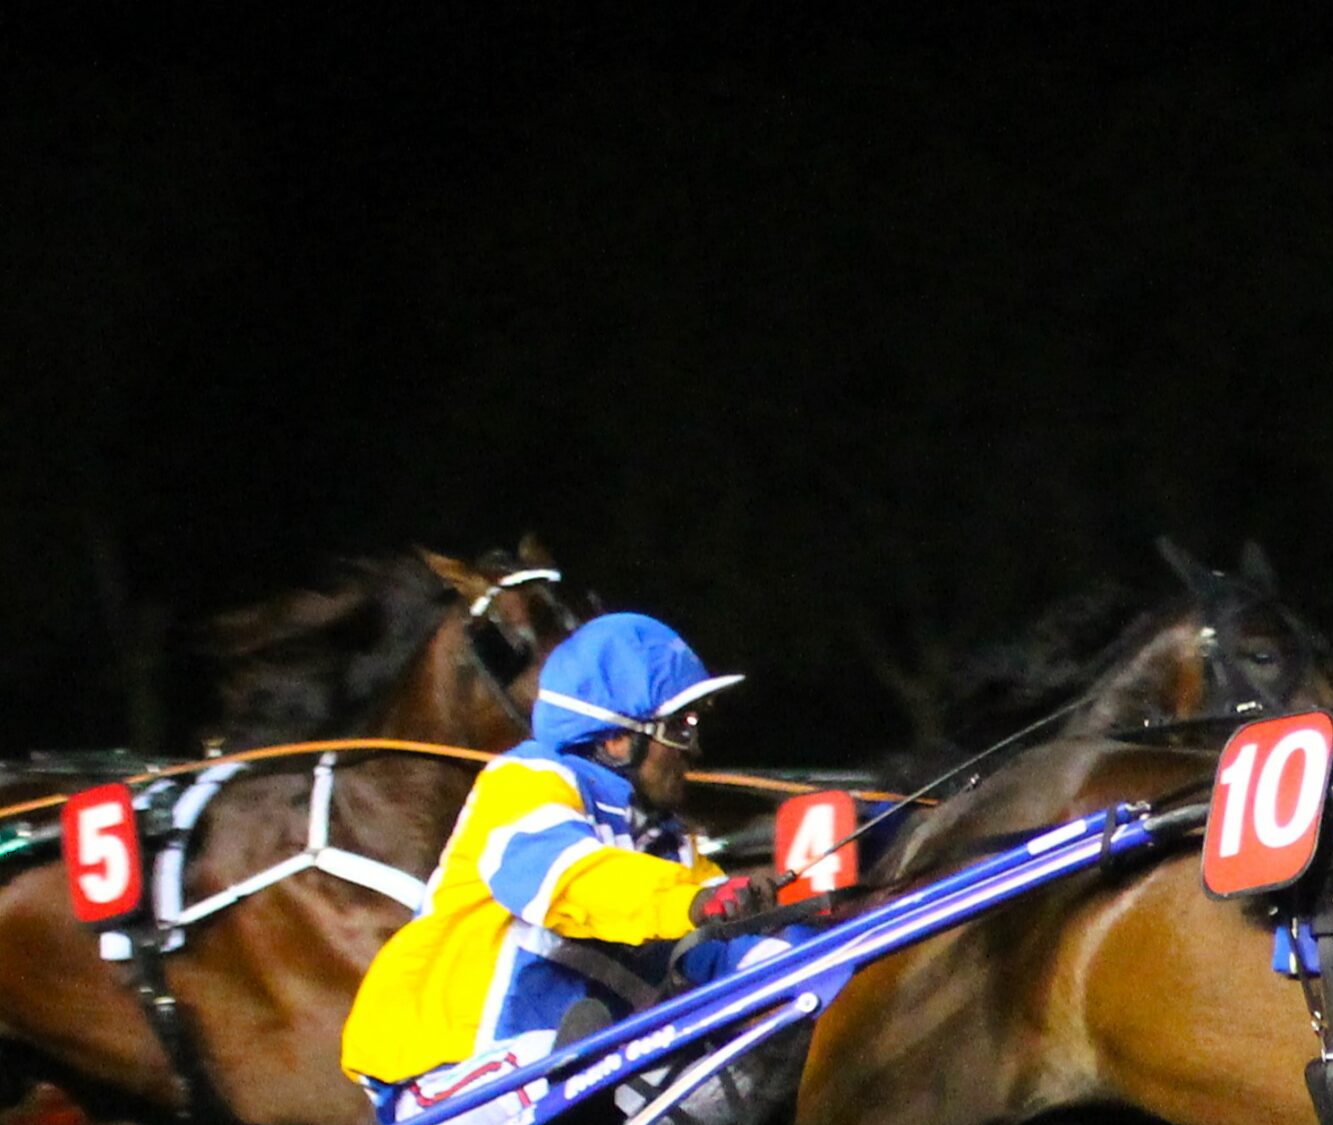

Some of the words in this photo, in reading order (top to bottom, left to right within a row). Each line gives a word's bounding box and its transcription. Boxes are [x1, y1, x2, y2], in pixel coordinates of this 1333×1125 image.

[1219, 728, 1331, 858] 10
[78, 801, 131, 904] 5
[785, 803, 842, 893] 4
